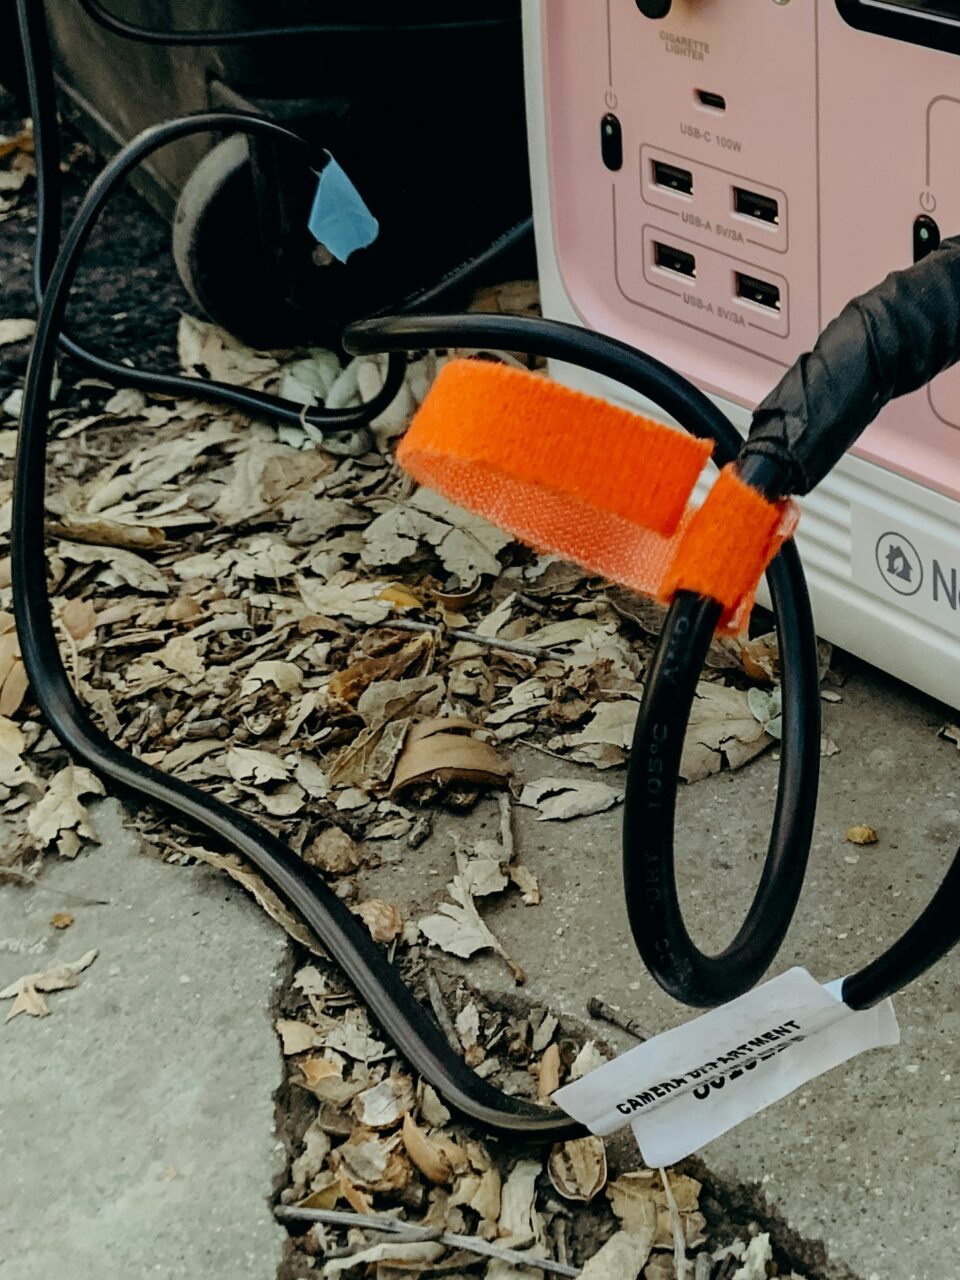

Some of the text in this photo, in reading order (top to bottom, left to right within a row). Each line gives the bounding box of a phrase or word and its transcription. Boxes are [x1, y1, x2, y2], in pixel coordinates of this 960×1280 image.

[659, 30, 710, 54] CIGARETTE
[665, 41, 705, 62] LIGHTER
[680, 123, 742, 153] USB-C 100W
[681, 211, 712, 232] USB-A
[683, 293, 714, 314] USB-A
[616, 1074, 688, 1115] CAMERA
